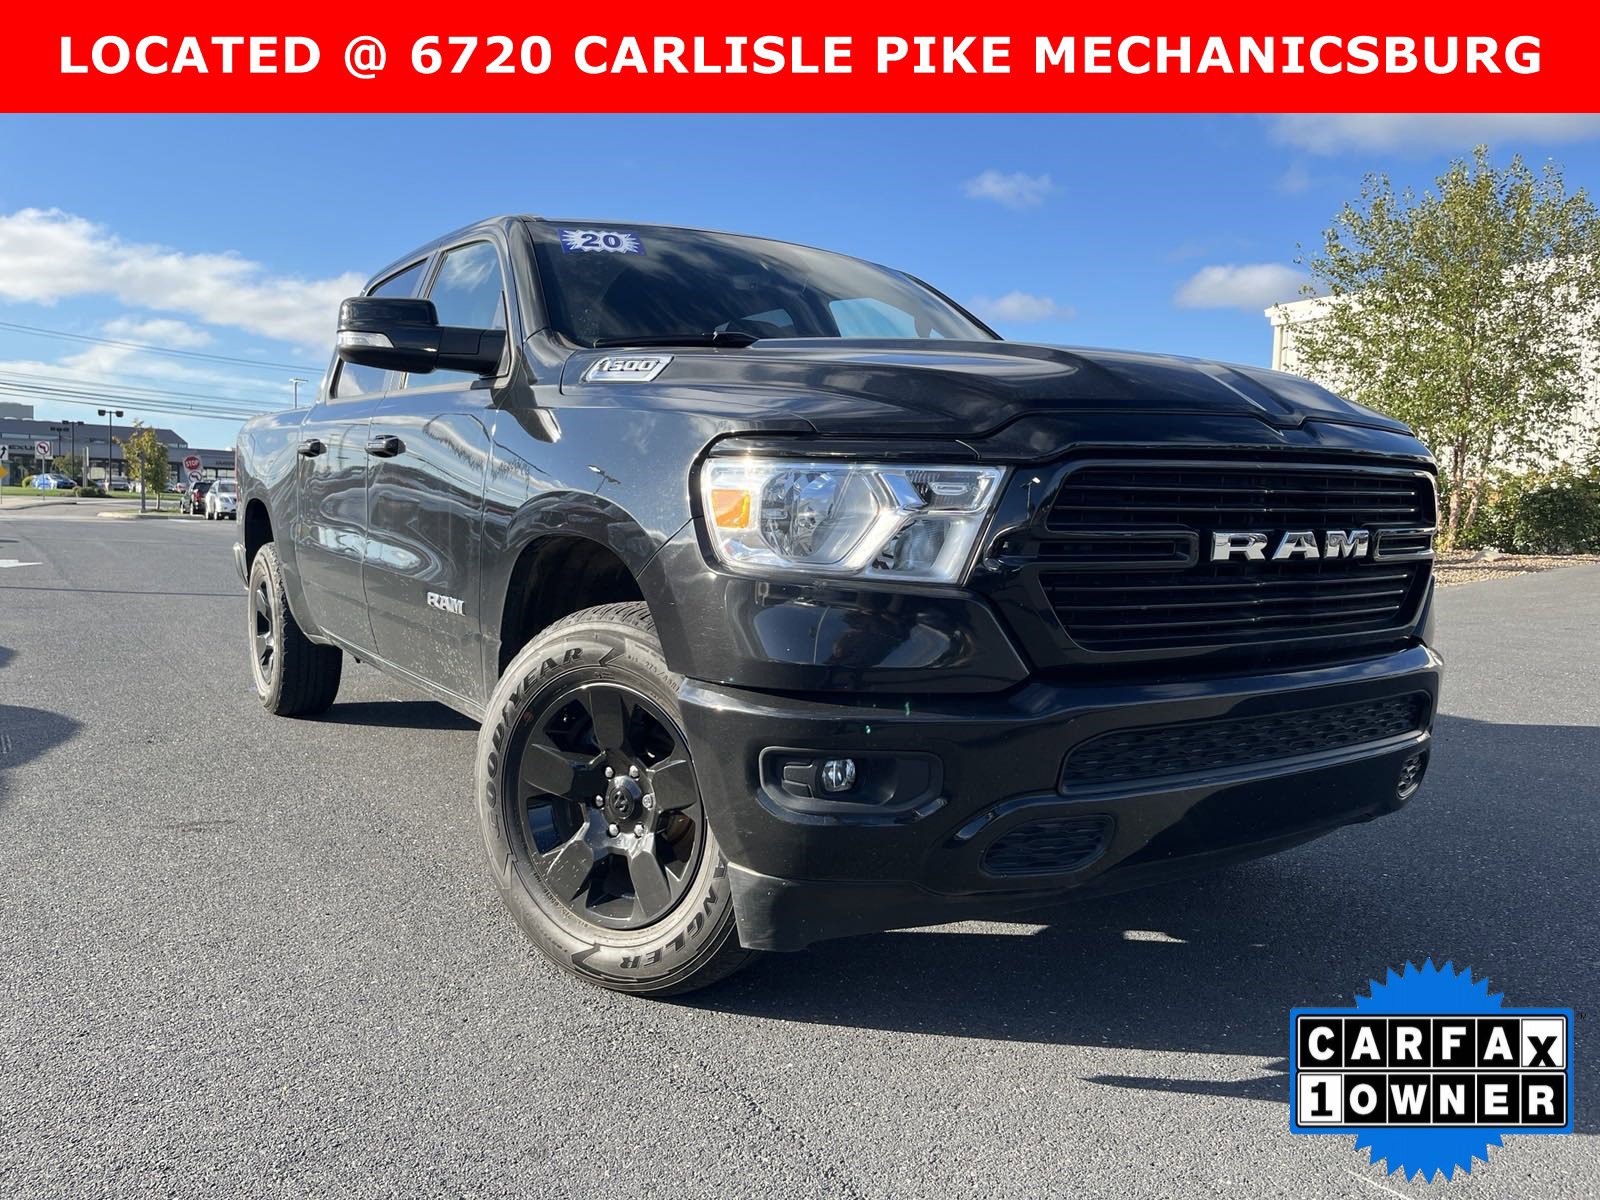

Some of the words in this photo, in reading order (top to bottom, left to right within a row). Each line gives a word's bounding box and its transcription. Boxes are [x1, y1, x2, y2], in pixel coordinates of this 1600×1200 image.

[580, 233, 621, 248] 20
[597, 359, 656, 372] 1500
[185, 460, 200, 468] STOP
[1210, 529, 1370, 561] RAM
[426, 591, 466, 617] RAM
[485, 646, 584, 839] GOODYEAR
[618, 850, 728, 969] ANGLER
